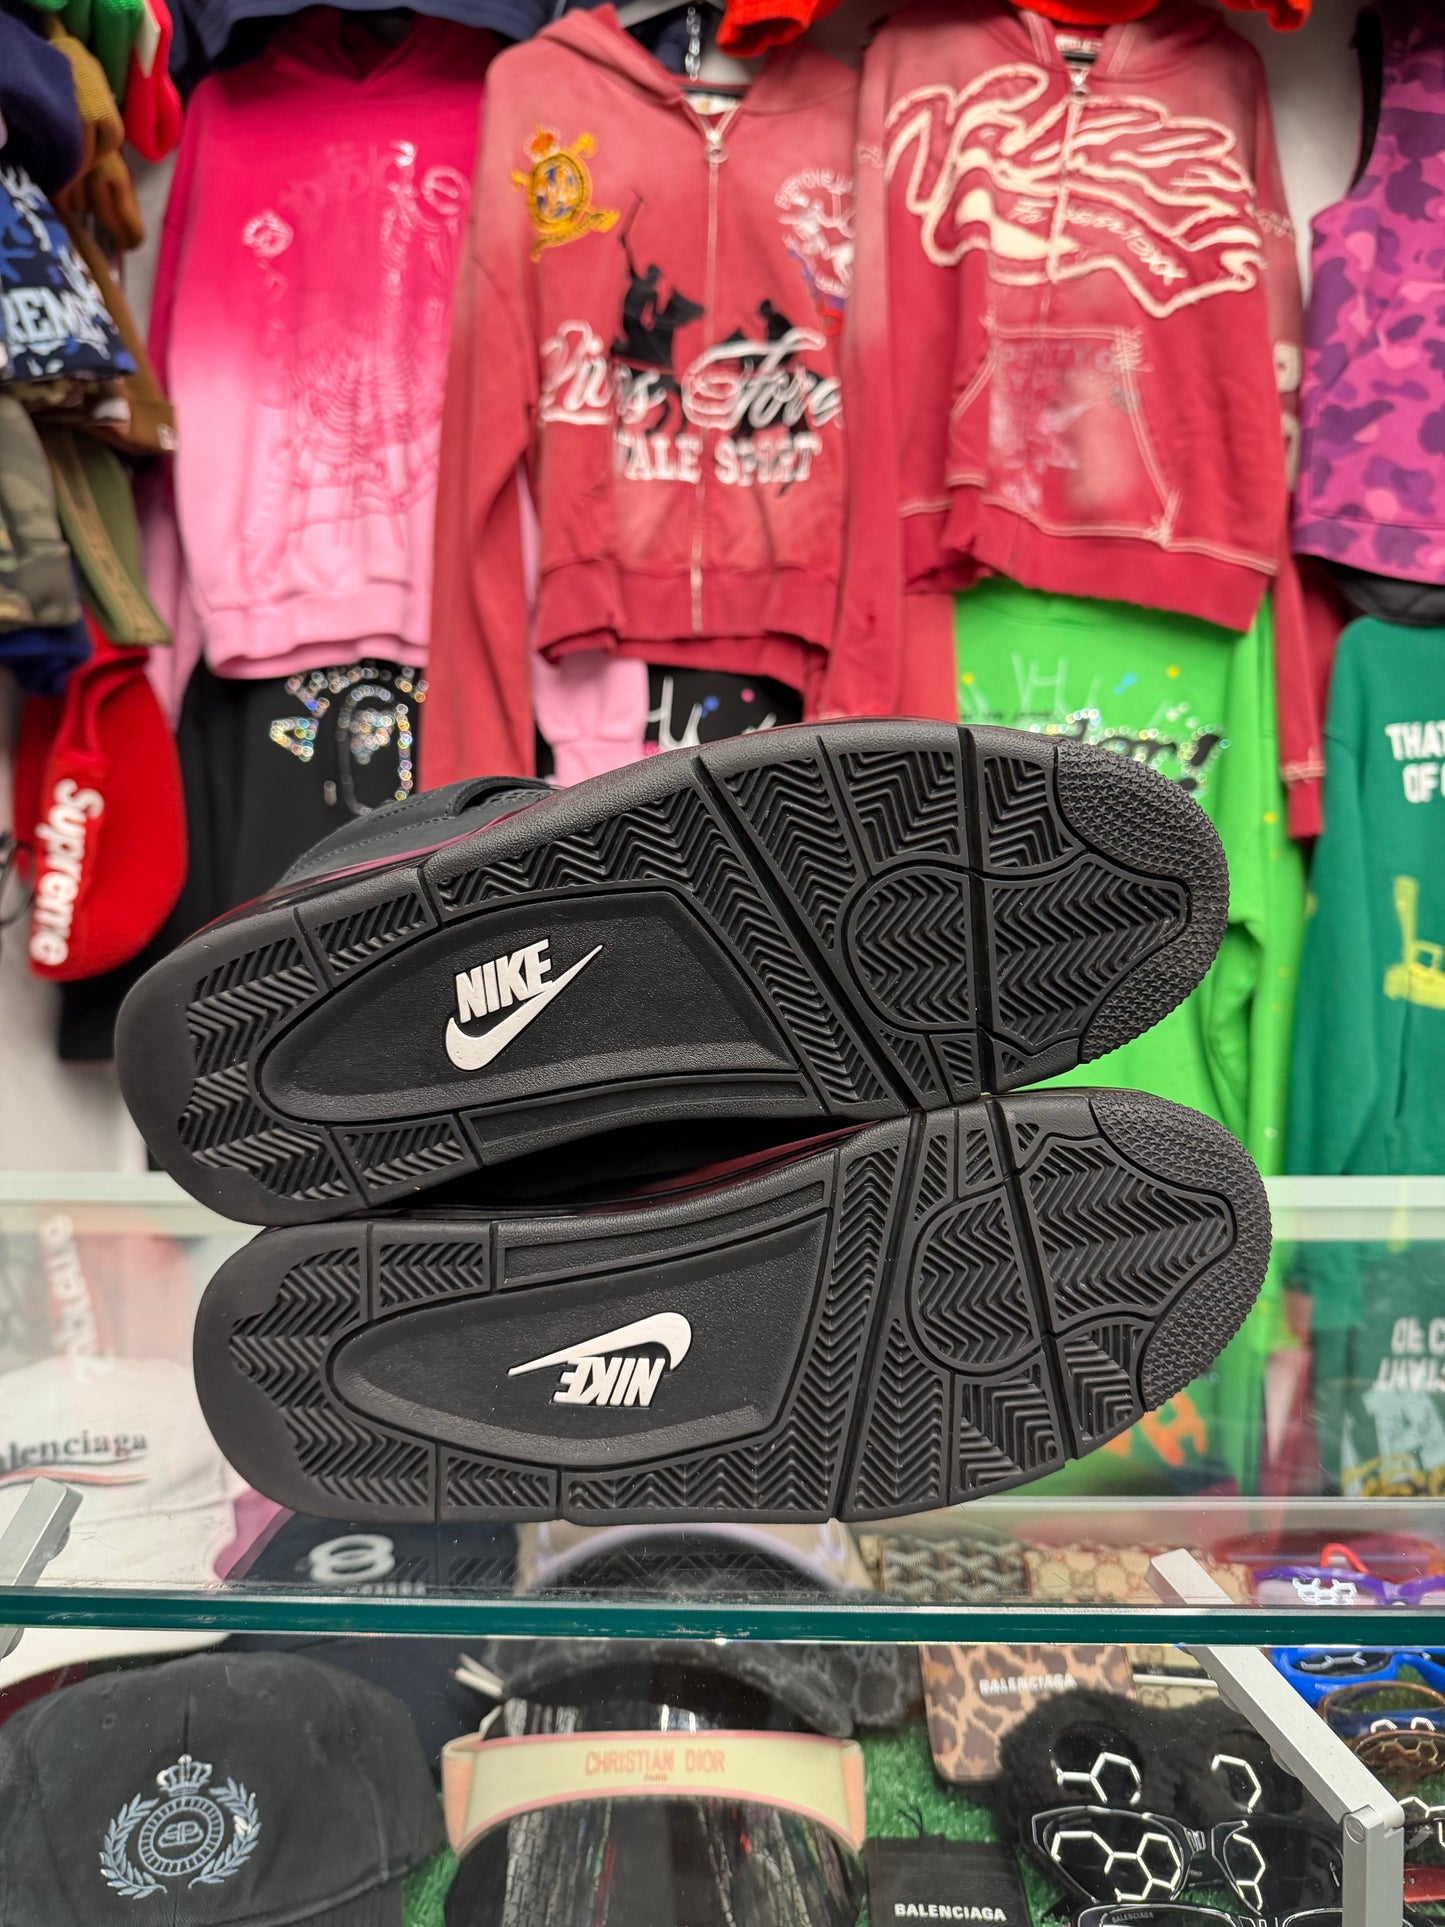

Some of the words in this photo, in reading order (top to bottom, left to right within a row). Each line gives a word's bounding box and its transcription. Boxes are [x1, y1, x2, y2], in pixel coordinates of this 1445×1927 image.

[29, 777, 105, 967] Supreme
[455, 938, 553, 1024] NIKE
[552, 1355, 667, 1408] NIKE
[0, 1428, 148, 1473] lenciaga
[979, 1672, 1078, 1698] BALENCIAGA
[584, 1749, 675, 1777] CHRISTIAN
[684, 1749, 726, 1773] DIOR
[893, 1902, 1008, 1922] BALENCIAGA
[1111, 1911, 1156, 1924] BALENCIAGA
